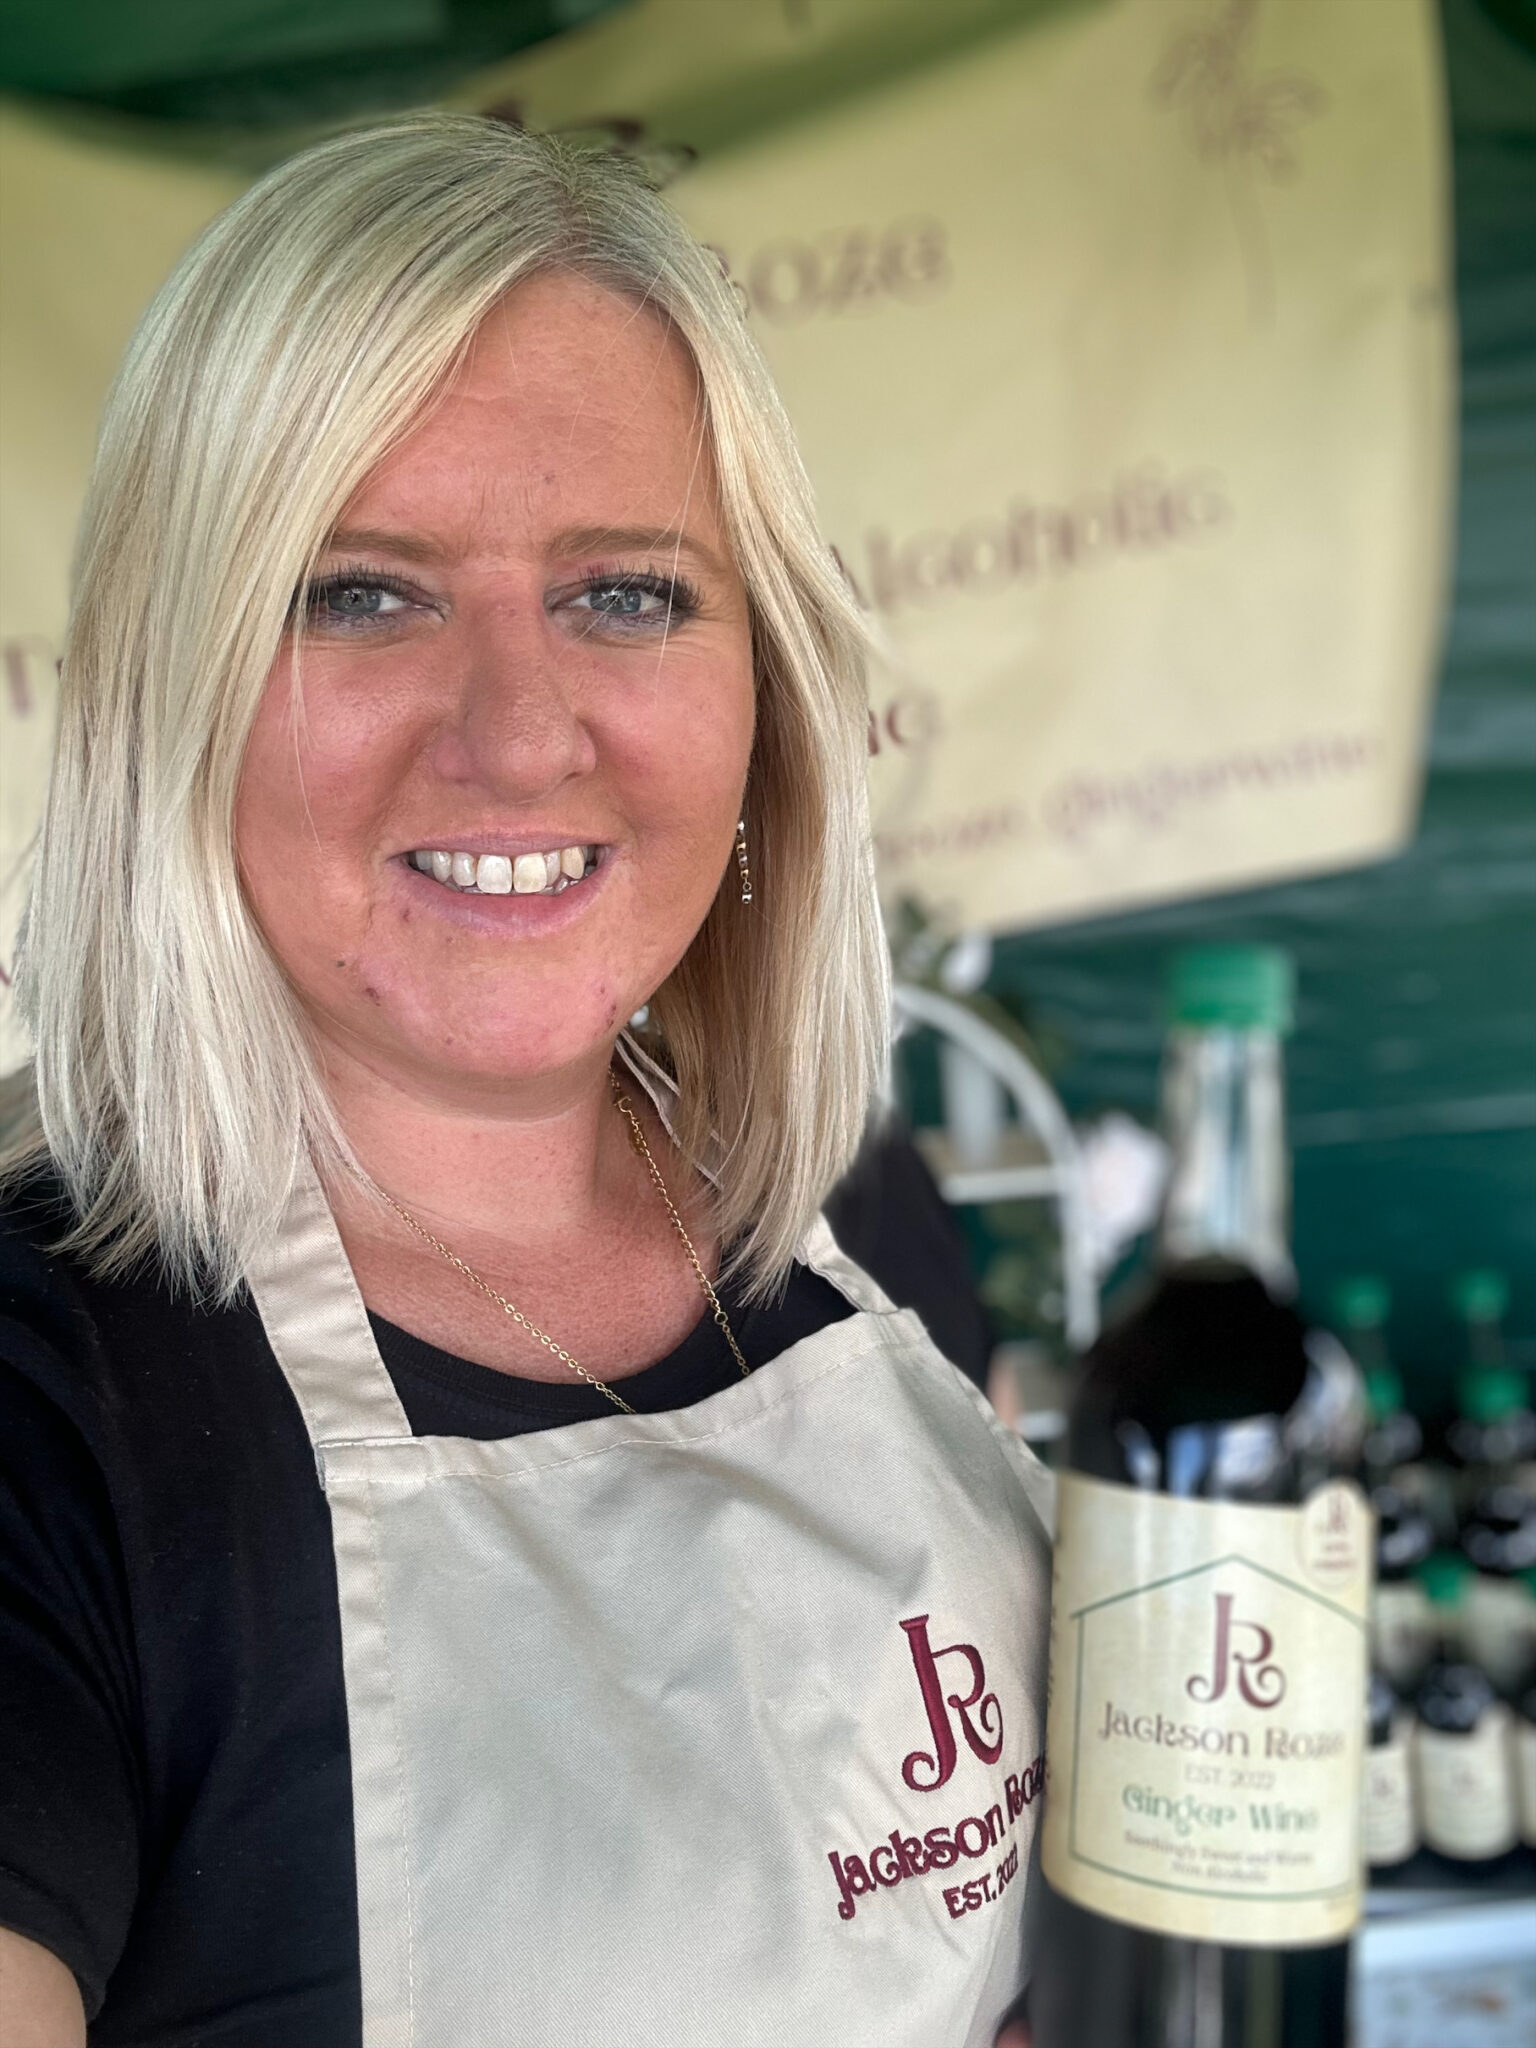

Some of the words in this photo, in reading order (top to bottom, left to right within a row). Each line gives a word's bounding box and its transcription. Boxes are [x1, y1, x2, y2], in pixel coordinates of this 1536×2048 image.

[898, 1613, 1004, 1793] JR
[1098, 1701, 1251, 1760] Jackson
[1122, 1784, 1238, 1837] Ginger
[1249, 1804, 1320, 1834] Wine
[827, 1803, 1006, 1921] Jackson
